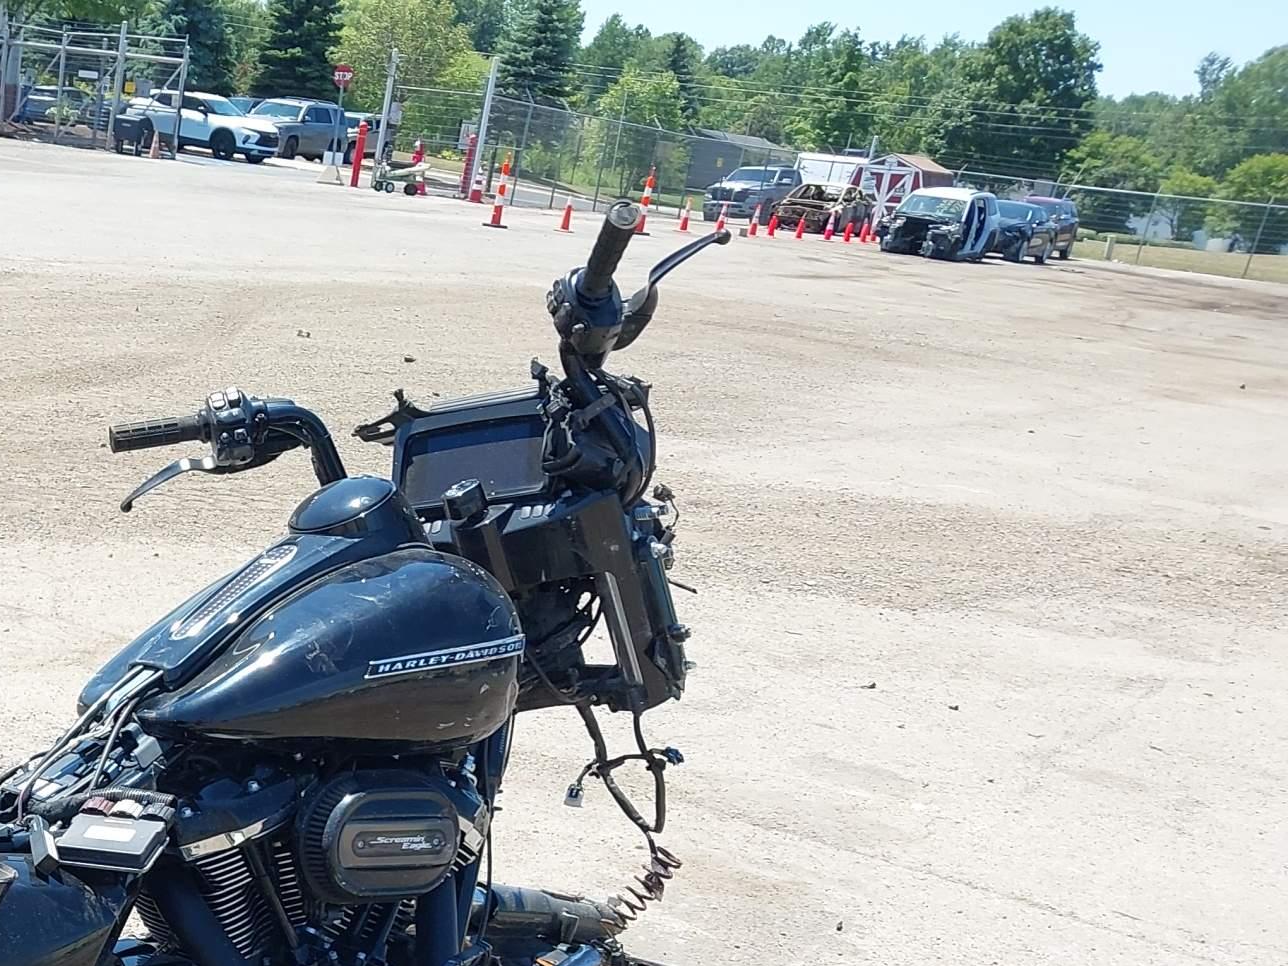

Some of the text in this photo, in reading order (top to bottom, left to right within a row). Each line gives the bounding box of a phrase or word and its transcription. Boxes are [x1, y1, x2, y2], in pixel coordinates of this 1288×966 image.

[334, 71, 353, 80] STOP
[377, 642, 523, 673] HARLEY-DAVIDSON
[401, 842, 432, 851] Eagle
